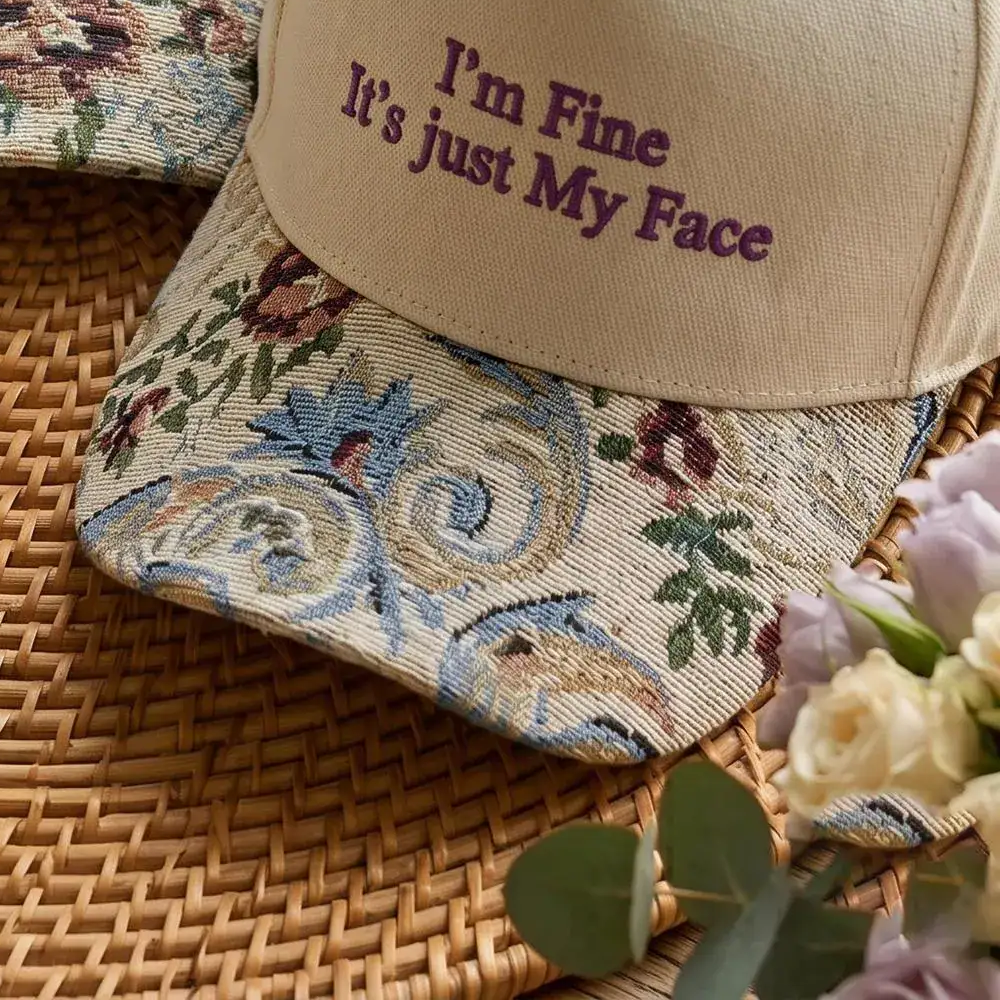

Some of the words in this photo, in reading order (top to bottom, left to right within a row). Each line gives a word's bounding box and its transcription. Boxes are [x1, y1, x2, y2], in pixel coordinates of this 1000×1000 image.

[341, 61, 406, 145] It's
[407, 106, 516, 195] just
[523, 151, 629, 239] My
[635, 184, 774, 262] Face
[434, 36, 526, 126] I'm
[537, 80, 670, 167] Fine
